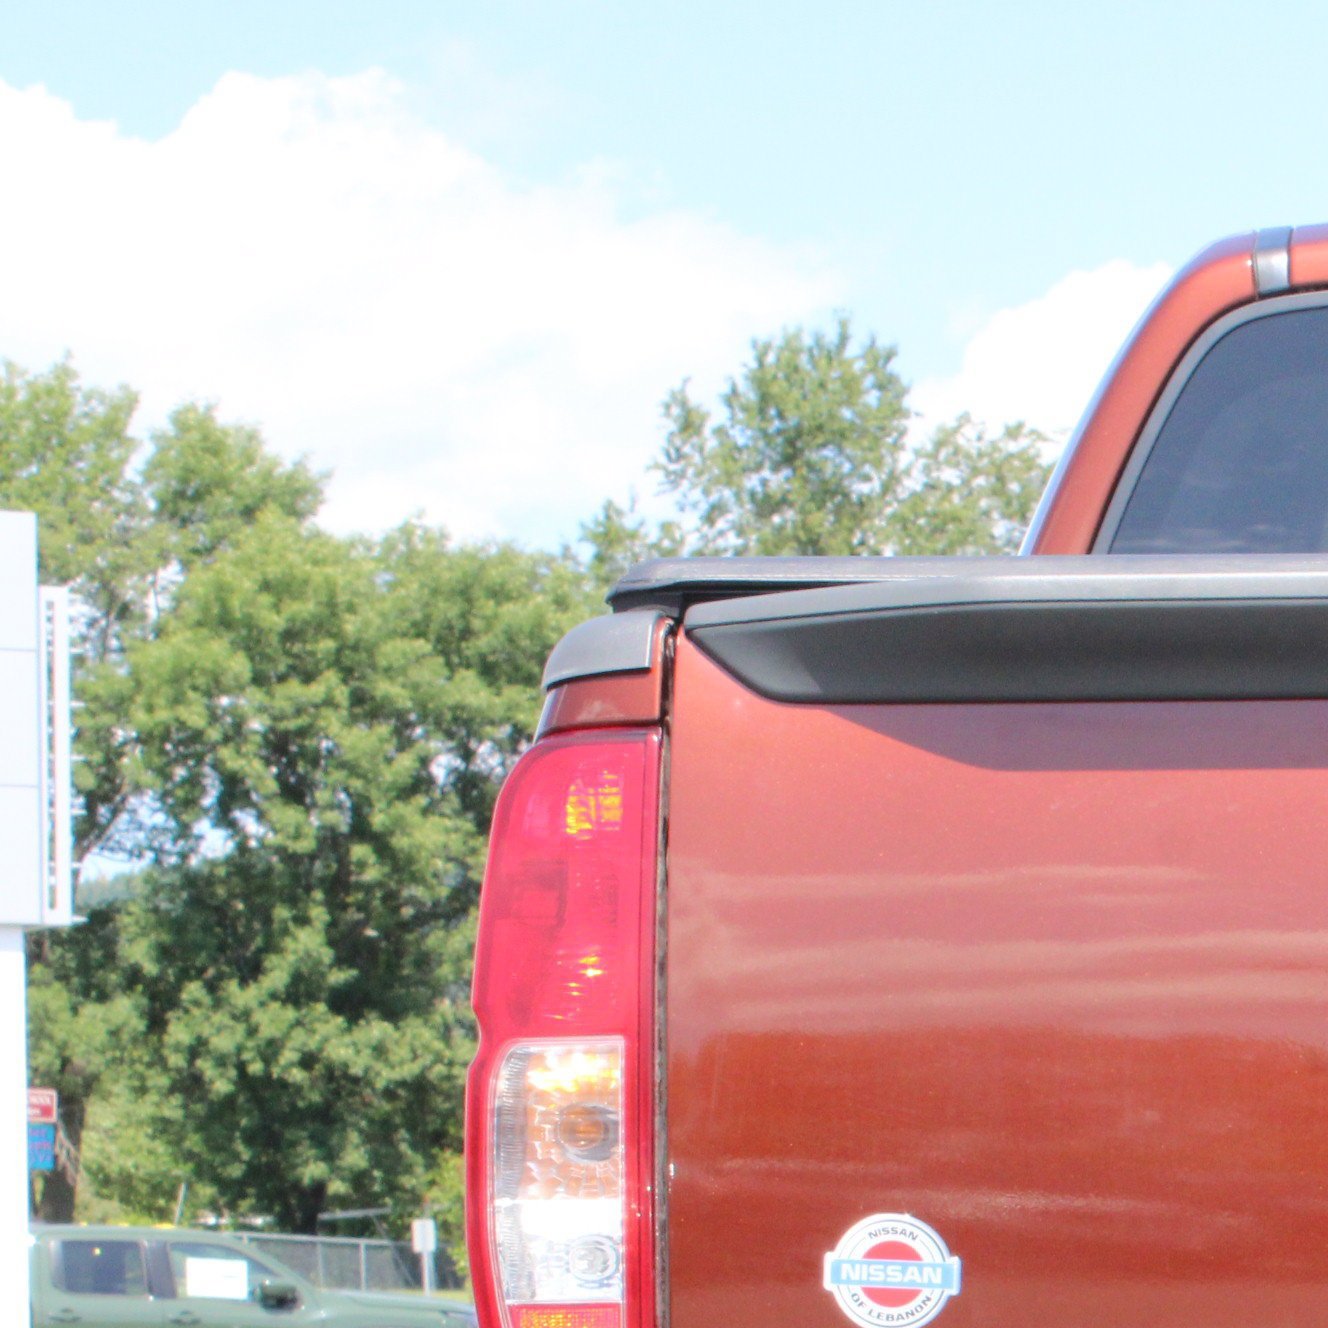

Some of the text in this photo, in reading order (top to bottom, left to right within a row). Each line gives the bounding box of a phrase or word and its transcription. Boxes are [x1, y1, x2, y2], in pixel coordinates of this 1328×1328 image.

[867, 1226, 919, 1241] NISSAN
[840, 1262, 943, 1284] NISSAN
[851, 1292, 932, 1322] OF LEBANON
